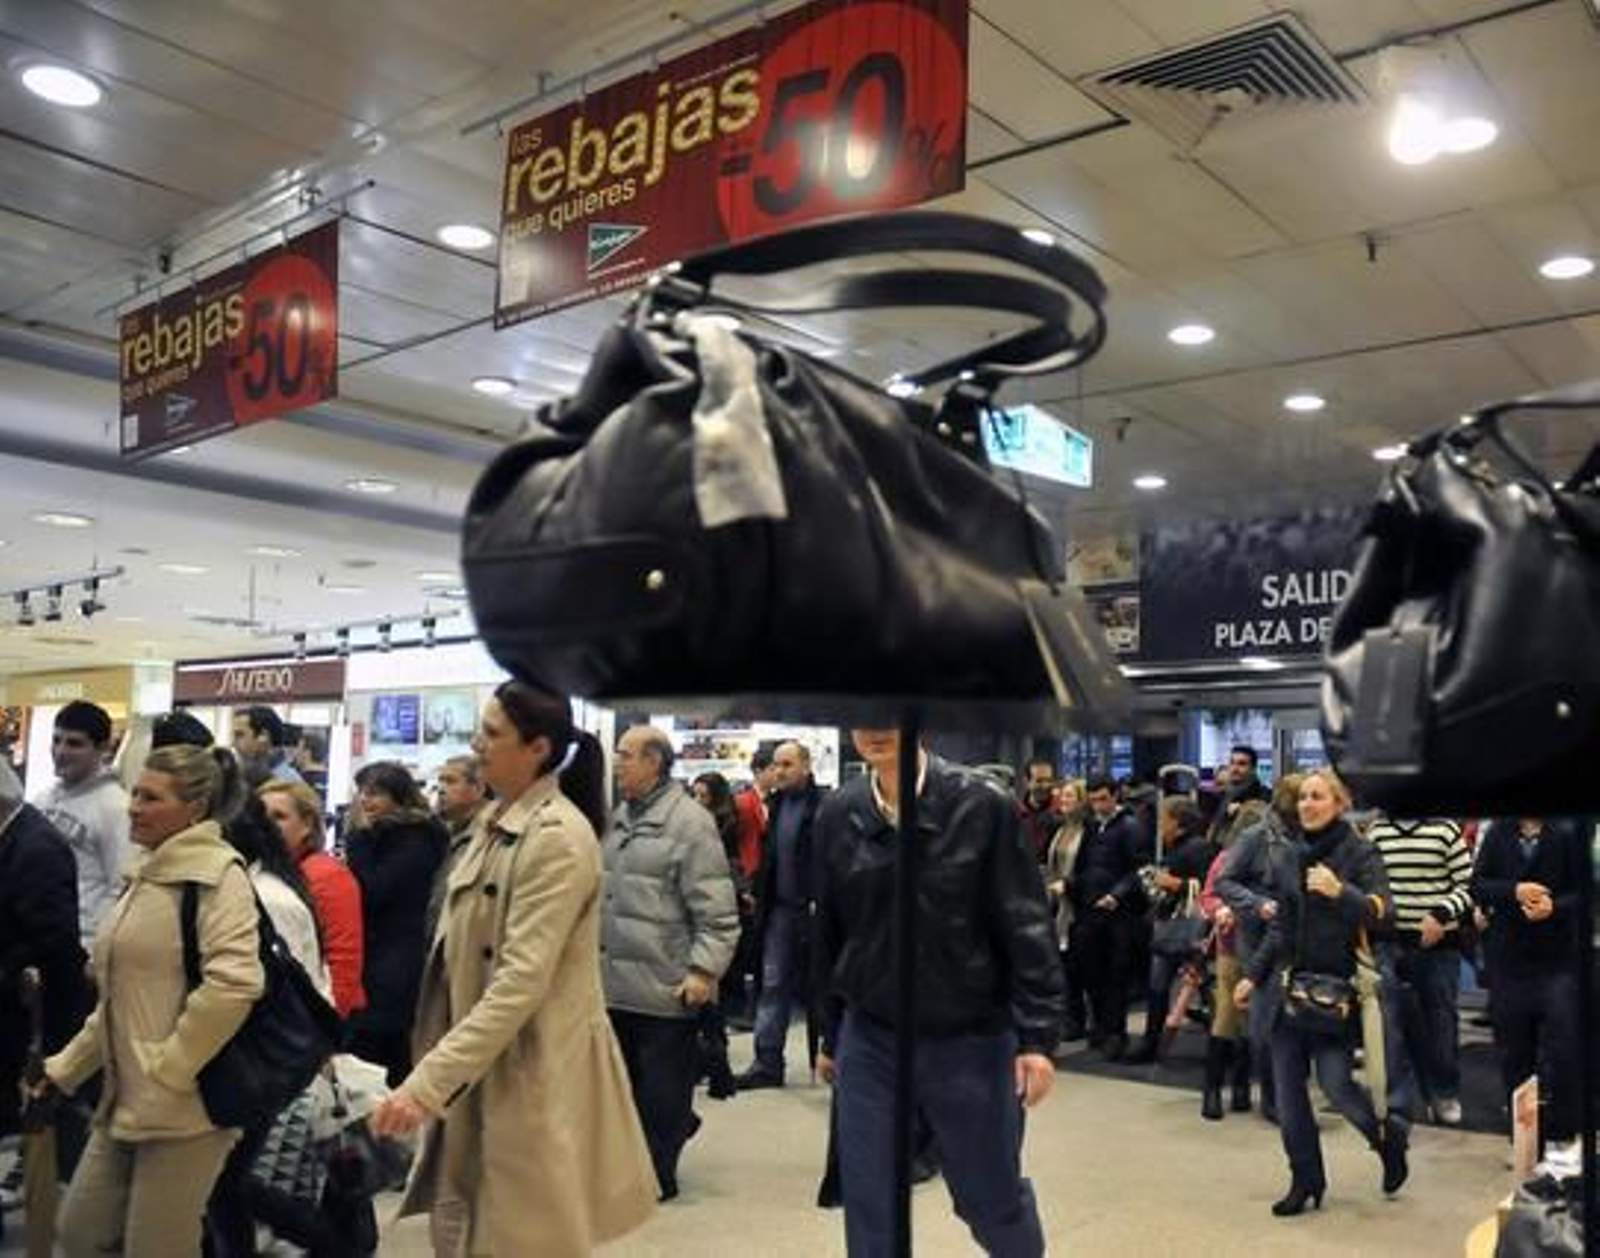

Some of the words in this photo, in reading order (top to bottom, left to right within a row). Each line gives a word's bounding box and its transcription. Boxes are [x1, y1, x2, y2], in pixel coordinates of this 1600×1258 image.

[506, 67, 761, 214] rebajas
[549, 178, 636, 230] quieres
[122, 292, 245, 379] rebajas
[1261, 569, 1351, 609] SALID
[1215, 620, 1293, 648] PLAZA
[1301, 617, 1332, 643] DE
[216, 667, 293, 696] SHISEIDO
